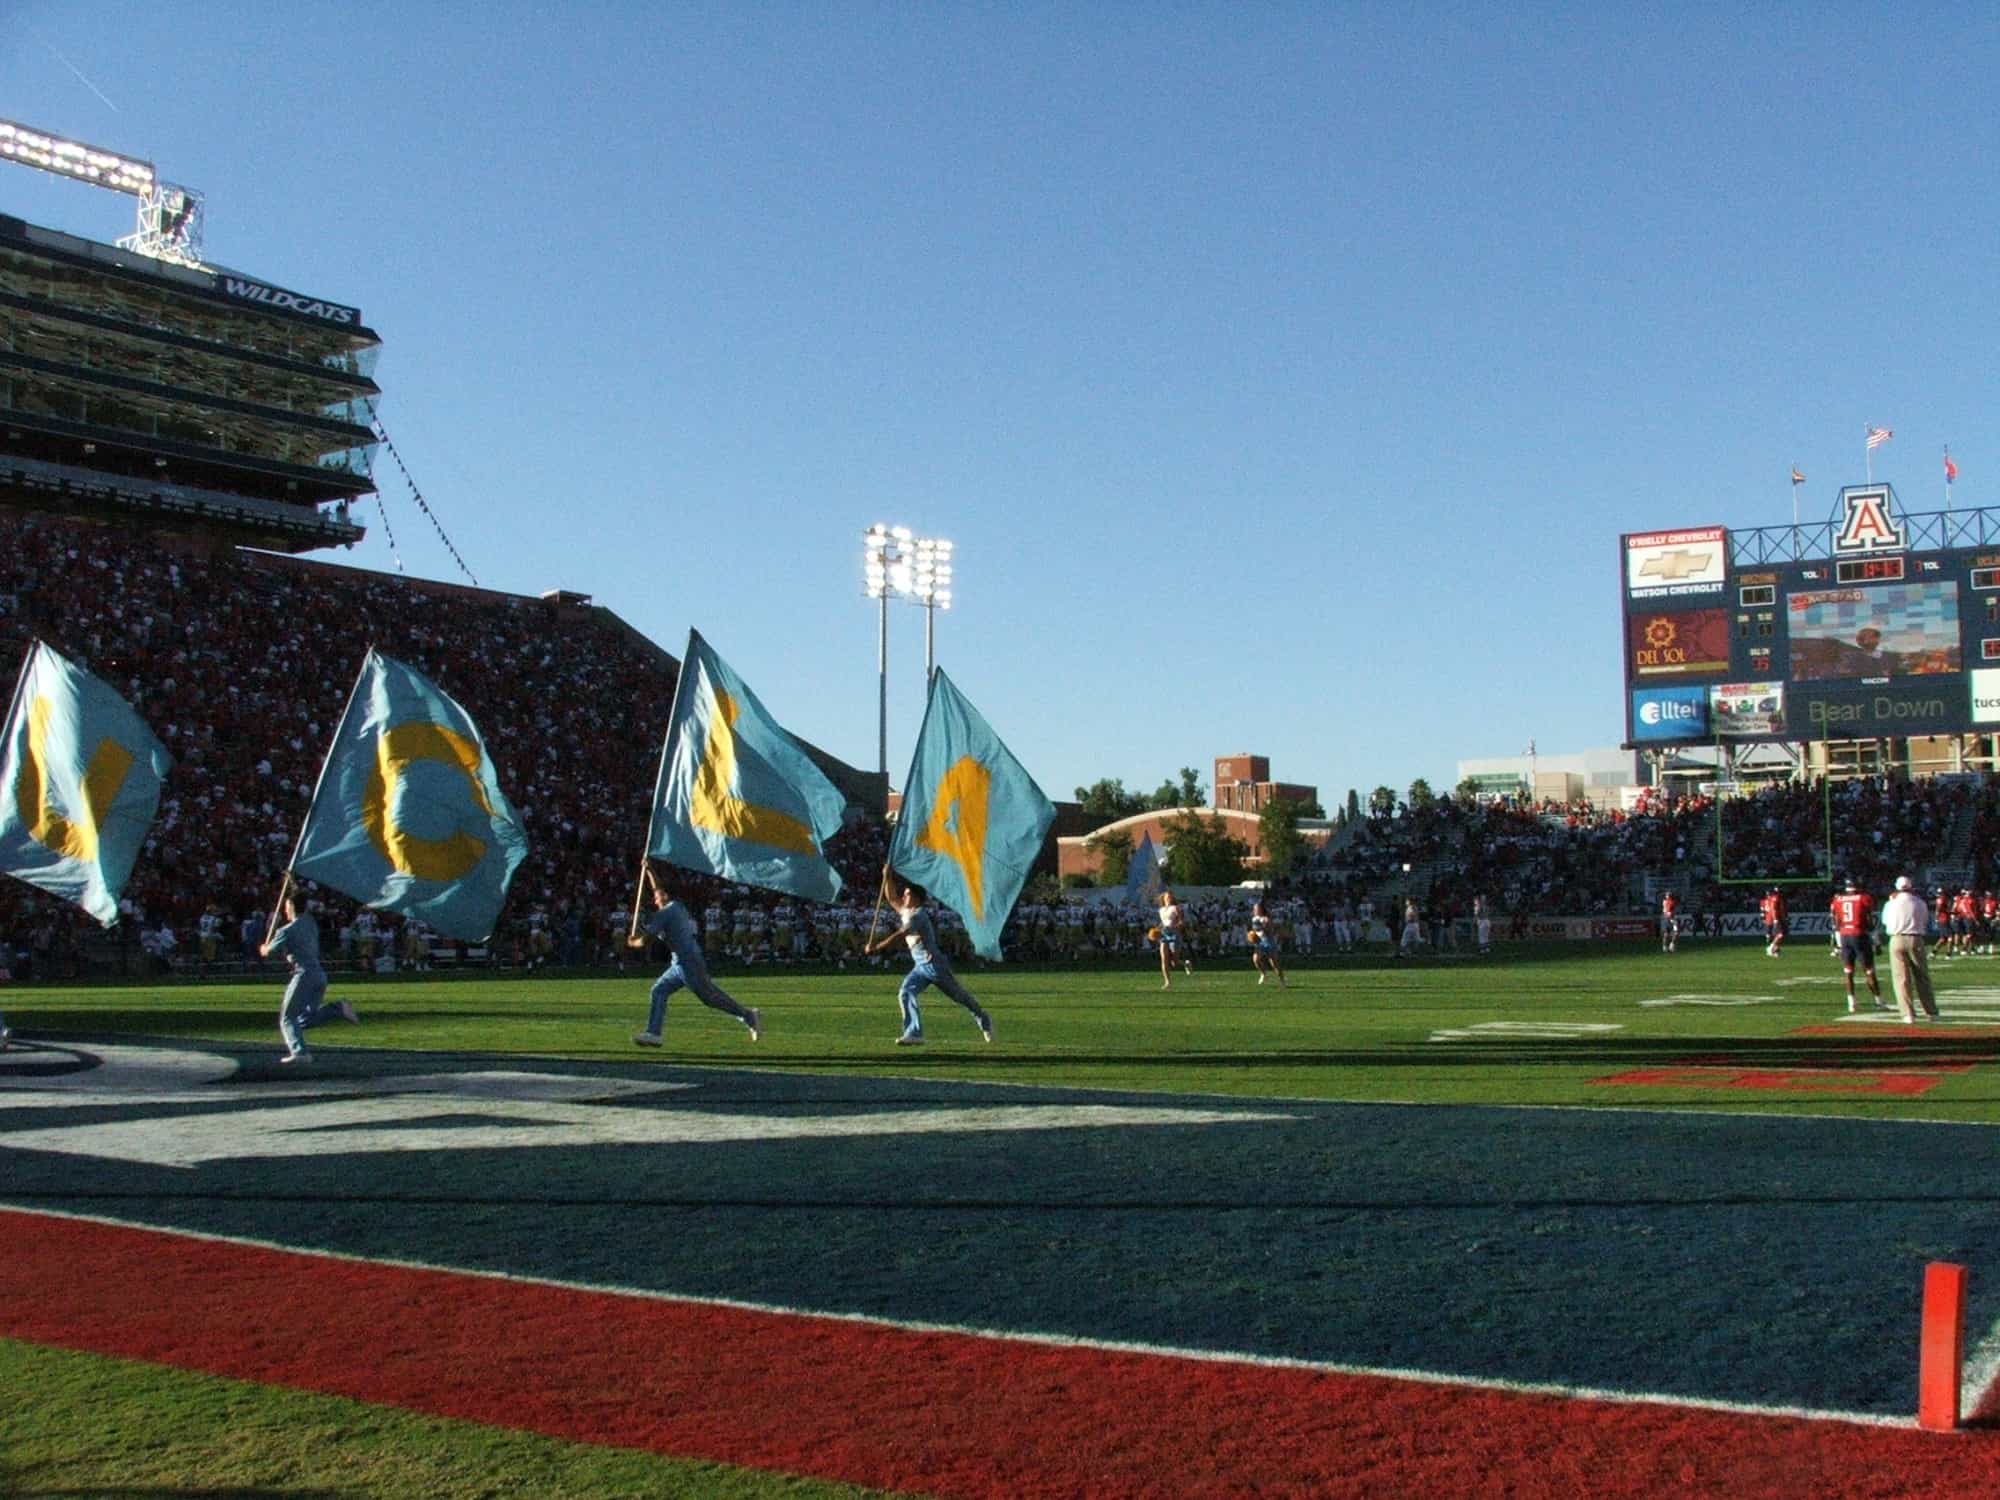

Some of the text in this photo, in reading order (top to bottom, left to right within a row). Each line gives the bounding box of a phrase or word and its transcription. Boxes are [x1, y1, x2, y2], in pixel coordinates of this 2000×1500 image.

[225, 278, 353, 323] WILDCATS
[1834, 489, 1905, 553] A
[1667, 531, 1721, 543] CHEVROLET
[1631, 583, 1723, 598] WATSON CHEVROLET
[1637, 648, 1686, 664] DEL SOL
[1640, 699, 1697, 724] alltel
[1808, 697, 1944, 722] Bear Down
[1842, 901, 1854, 922] 9
